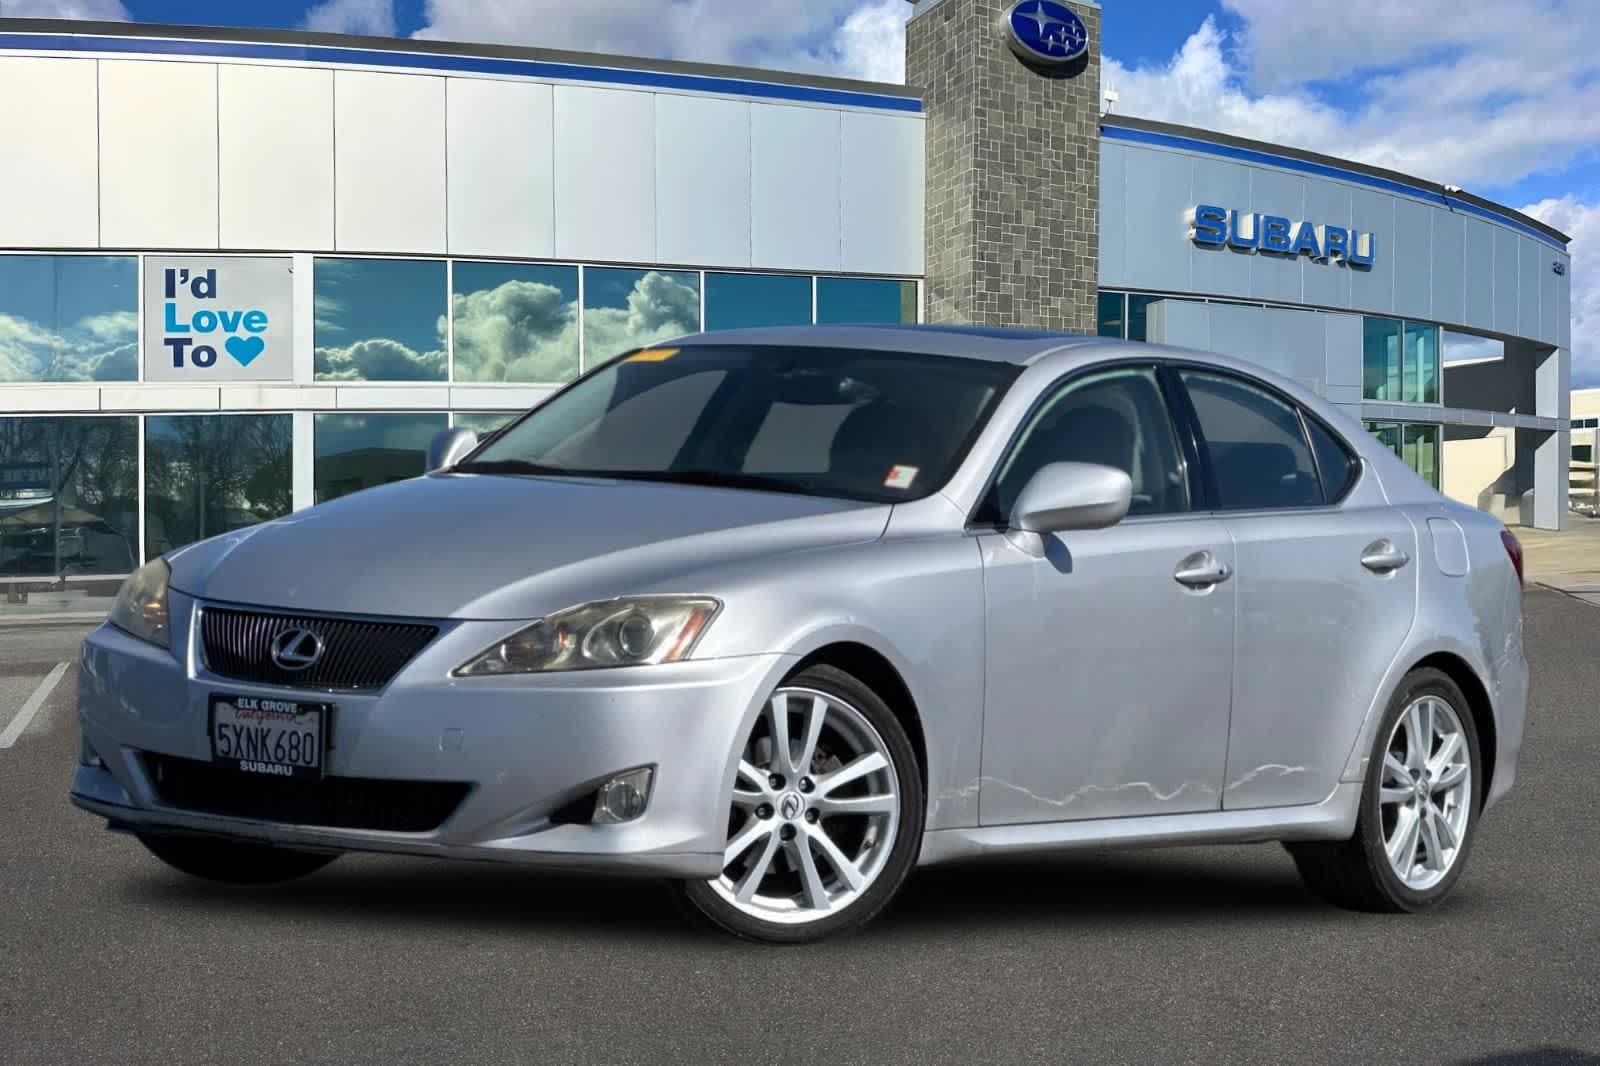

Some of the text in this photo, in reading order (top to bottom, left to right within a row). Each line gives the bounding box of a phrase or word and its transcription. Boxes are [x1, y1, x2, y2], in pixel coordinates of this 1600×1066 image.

[1190, 204, 1376, 268] SUBARU
[164, 302, 269, 333] Love
[163, 337, 218, 368] To
[238, 697, 297, 713] ELK GROVE
[218, 723, 314, 765] 5XNK680
[240, 760, 293, 776] SUBARU
